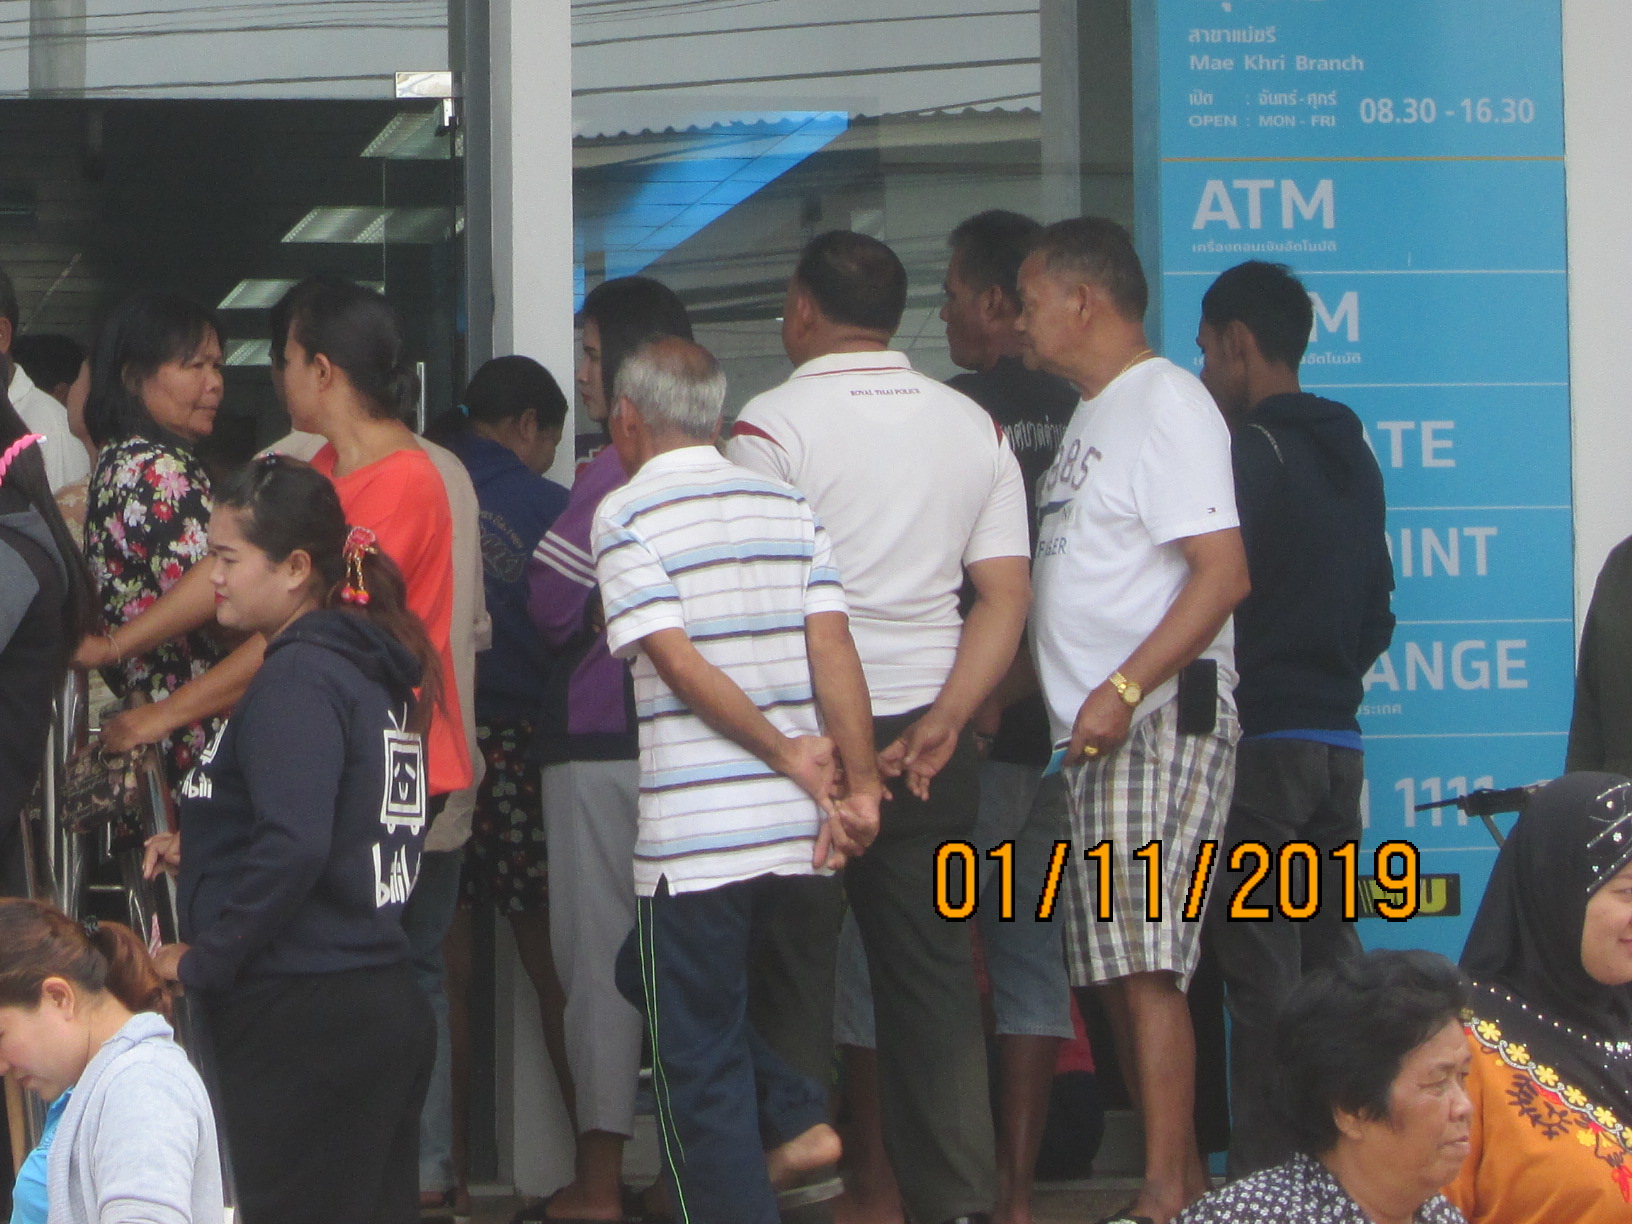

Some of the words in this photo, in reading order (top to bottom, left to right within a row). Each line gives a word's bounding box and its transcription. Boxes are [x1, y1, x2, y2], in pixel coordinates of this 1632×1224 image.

[1190, 55, 1234, 71] Mae
[1244, 54, 1286, 71] Khri
[1296, 54, 1365, 71] Branch
[1189, 115, 1238, 127] OPEN
[1259, 115, 1296, 127] MON
[1311, 115, 1336, 126] FRI
[1359, 97, 1437, 123] 08.30
[1460, 97, 1535, 123] 16.30
[1192, 179, 1335, 229] ATM
[1386, 528, 1498, 577] INT
